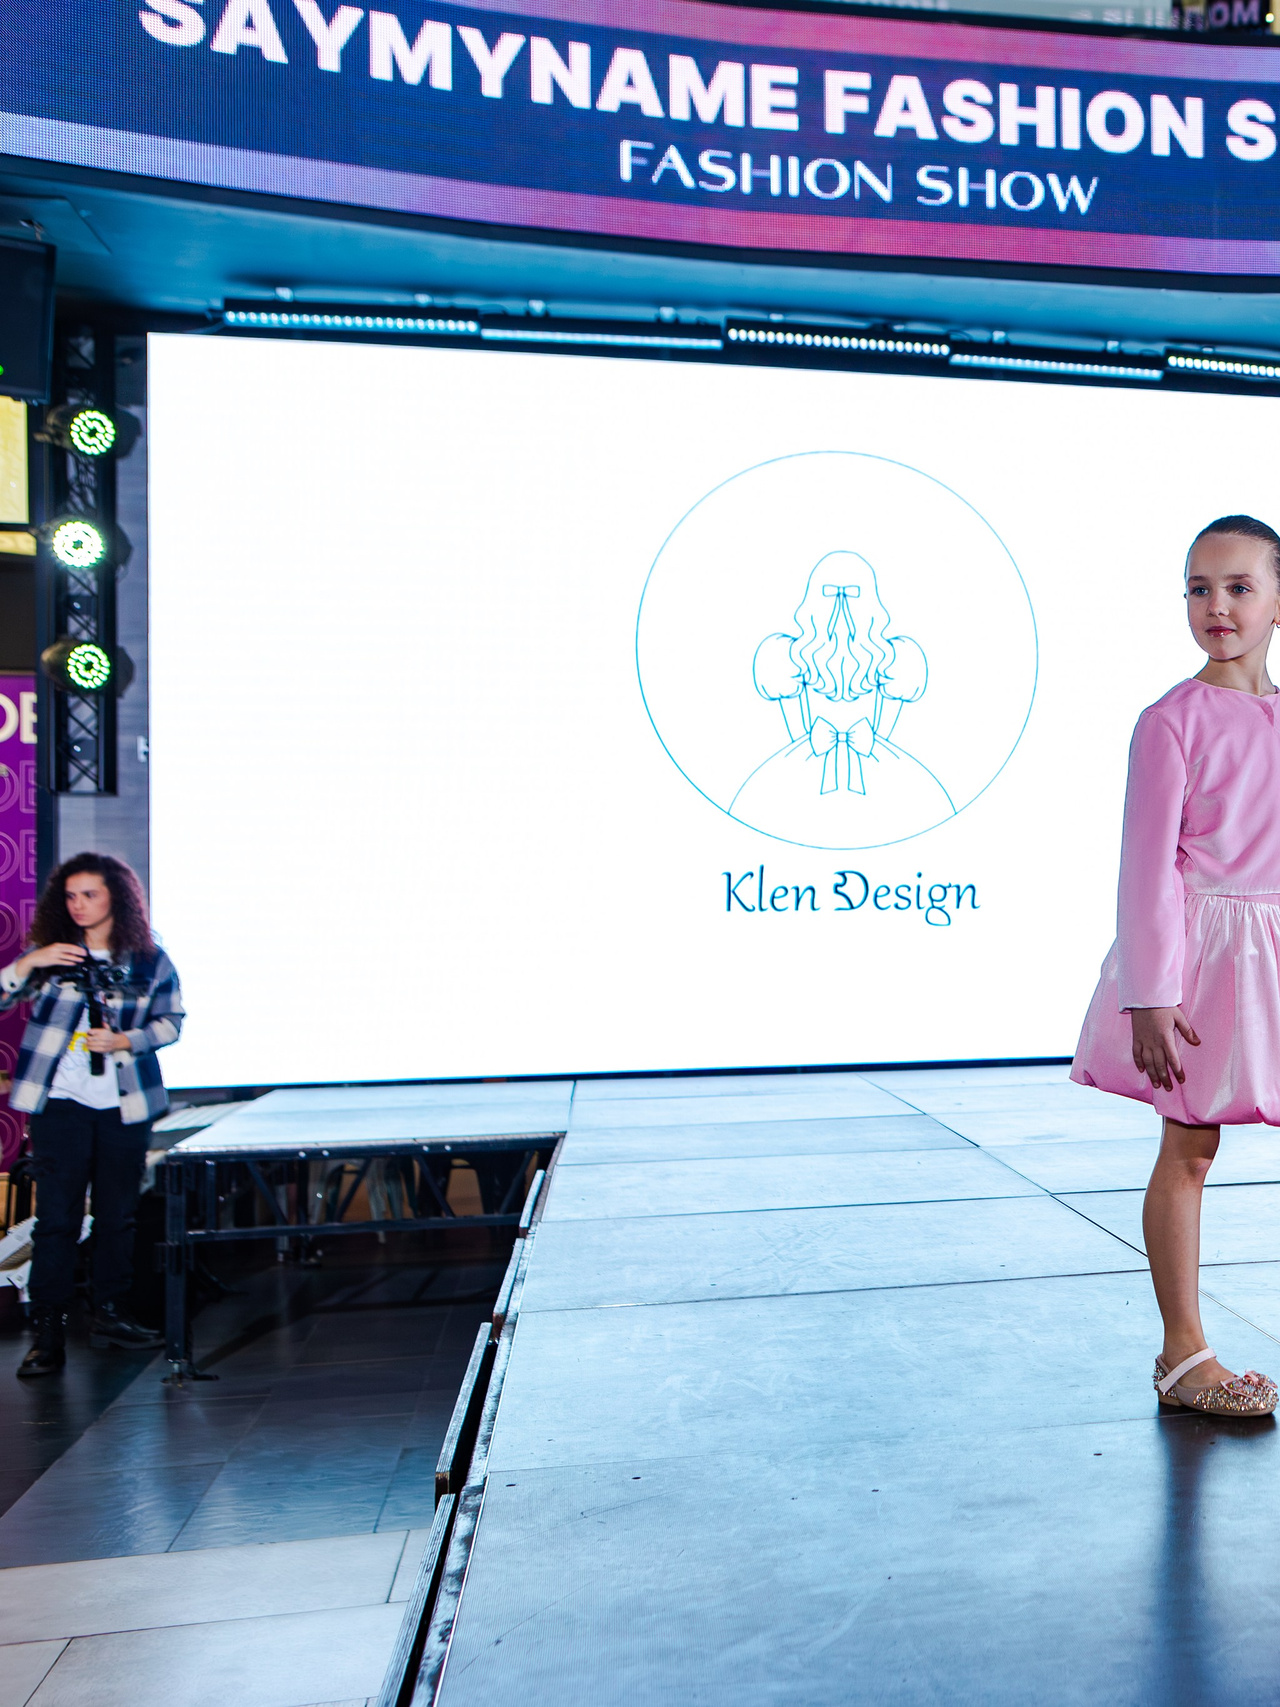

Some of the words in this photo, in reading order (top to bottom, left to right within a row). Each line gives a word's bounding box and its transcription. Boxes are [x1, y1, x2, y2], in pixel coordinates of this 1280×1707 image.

[138, 0, 799, 131] SAYMYNAME
[824, 69, 1204, 158] FASHION
[620, 139, 893, 203] FASHION
[916, 165, 1099, 215] SHOW
[721, 864, 821, 912] Klen
[833, 869, 981, 926] Design
